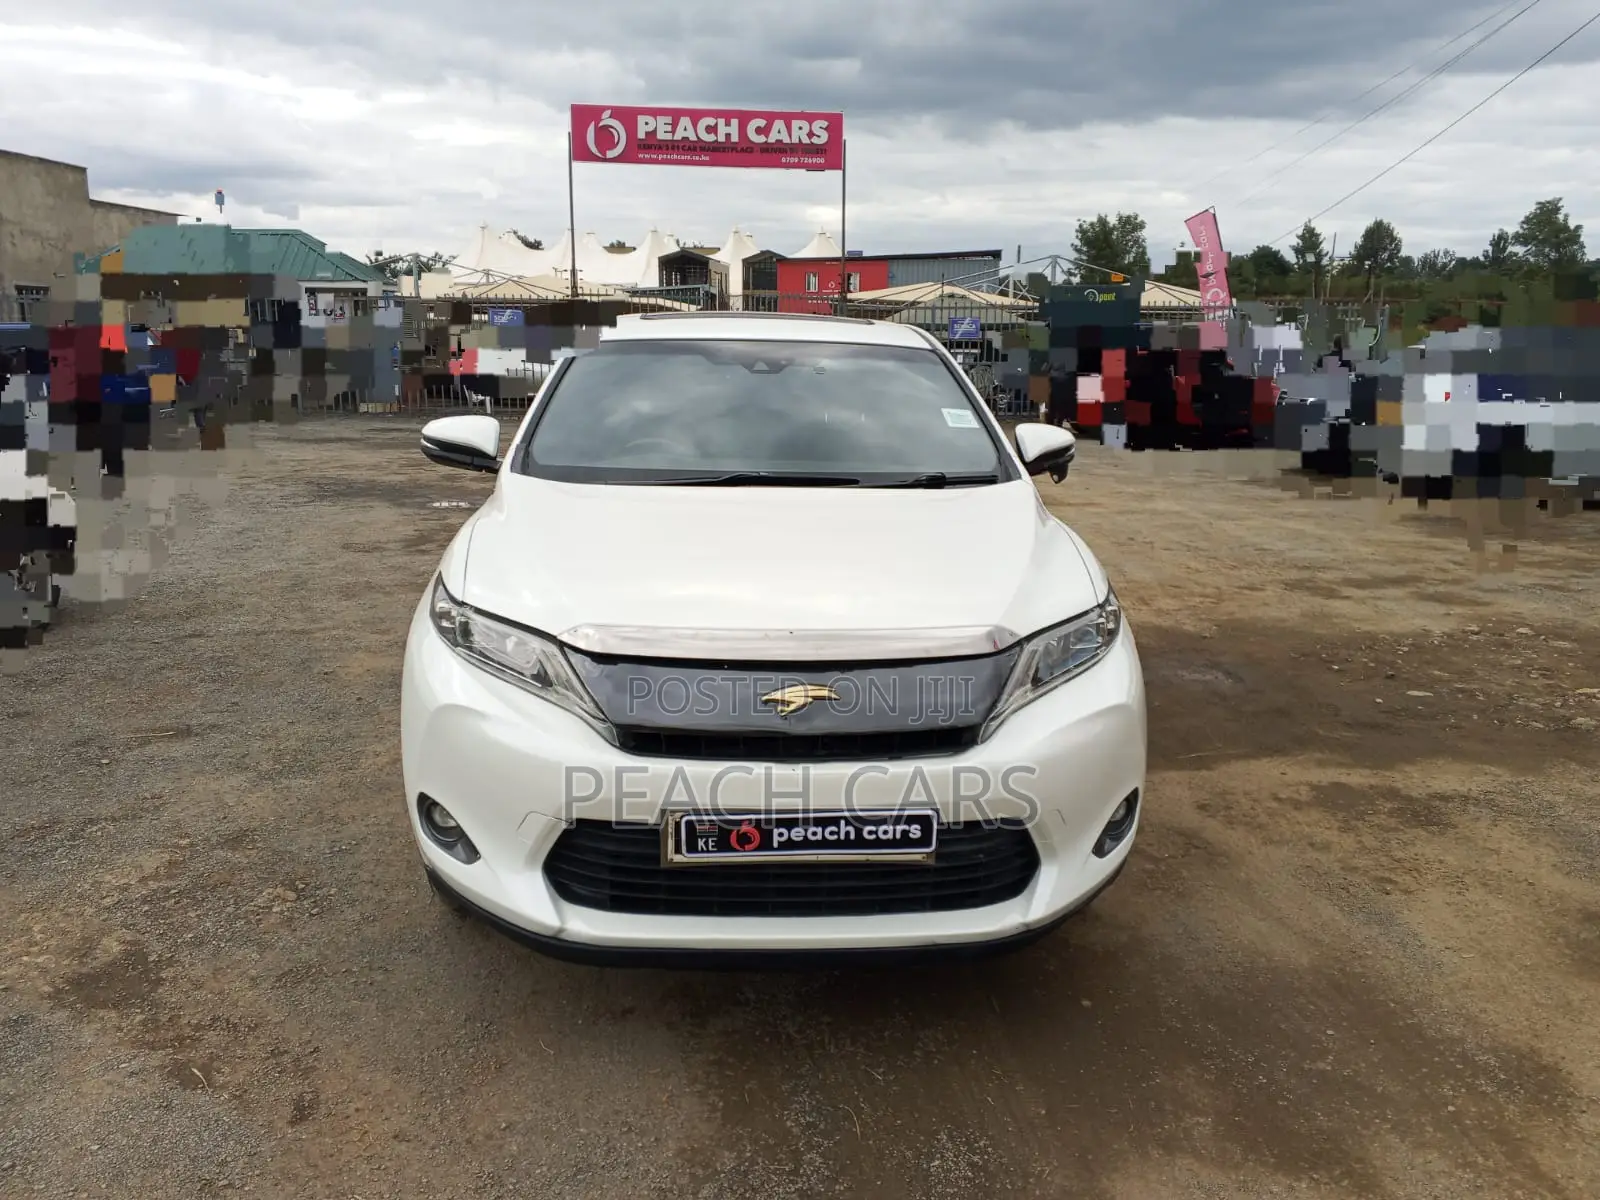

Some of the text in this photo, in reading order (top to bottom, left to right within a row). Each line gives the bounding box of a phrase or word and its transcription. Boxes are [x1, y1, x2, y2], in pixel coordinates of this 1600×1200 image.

[637, 115, 829, 144] PEACH CARS
[697, 837, 717, 851] KE
[772, 819, 922, 848] peach cars
